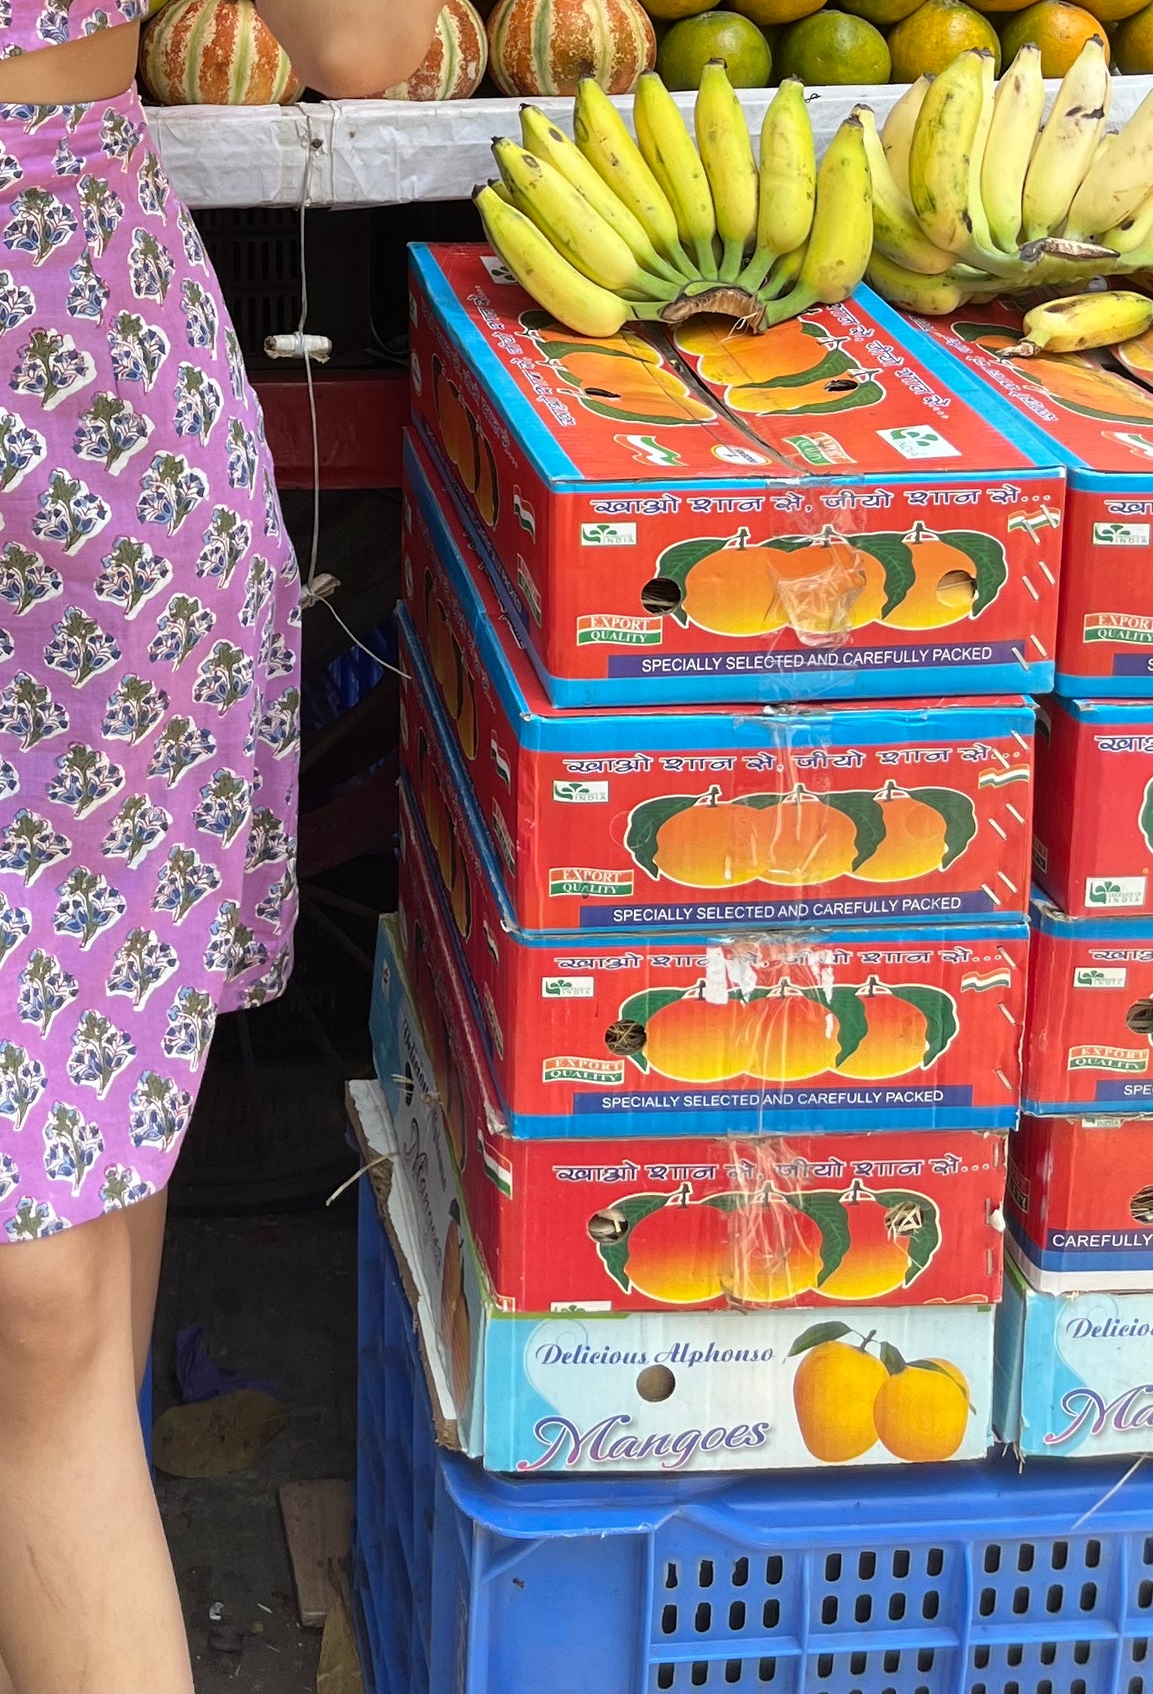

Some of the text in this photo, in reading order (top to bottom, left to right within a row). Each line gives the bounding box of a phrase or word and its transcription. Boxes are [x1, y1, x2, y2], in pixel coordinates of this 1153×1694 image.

[590, 493, 681, 514] खाओ
[687, 497, 765, 512] शान
[820, 488, 895, 508] जीयो
[904, 488, 981, 506] शान
[602, 536, 634, 544] INDIA
[1114, 536, 1148, 544] INDIA
[590, 616, 651, 631] EXPORT
[591, 630, 648, 643] QUALITY
[641, 646, 993, 673] SPECIALLY SELECTED AND CAREFULLY PACKED
[563, 752, 653, 773] खाओ
[659, 756, 736, 772] शान
[794, 750, 866, 770] जीयो
[875, 748, 952, 766] शान
[574, 794, 607, 802] INDIA
[562, 869, 622, 884] EXPORT
[562, 882, 619, 896] QUALITY
[613, 897, 961, 923] SPECIALLY SELECTED AND CAREFULLY PACKED
[555, 953, 641, 970] खाओ
[858, 950, 933, 966] शान
[1081, 1047, 1147, 1060] EXPORT
[555, 1058, 624, 1072] EXPORT
[550, 1069, 618, 1083] QUALITY
[602, 1089, 944, 1109] SPECIALLY SELECTED AND CAREFULLY PACKED
[553, 1160, 638, 1182] खाओ
[645, 1164, 719, 1181] शान
[851, 1159, 924, 1177] शान
[1052, 1233, 1153, 1248] CAREFULLY
[1066, 1317, 1153, 1339] Delicio
[535, 1341, 774, 1367] Delicious Alphonso
[517, 1413, 770, 1472] Mangoes
